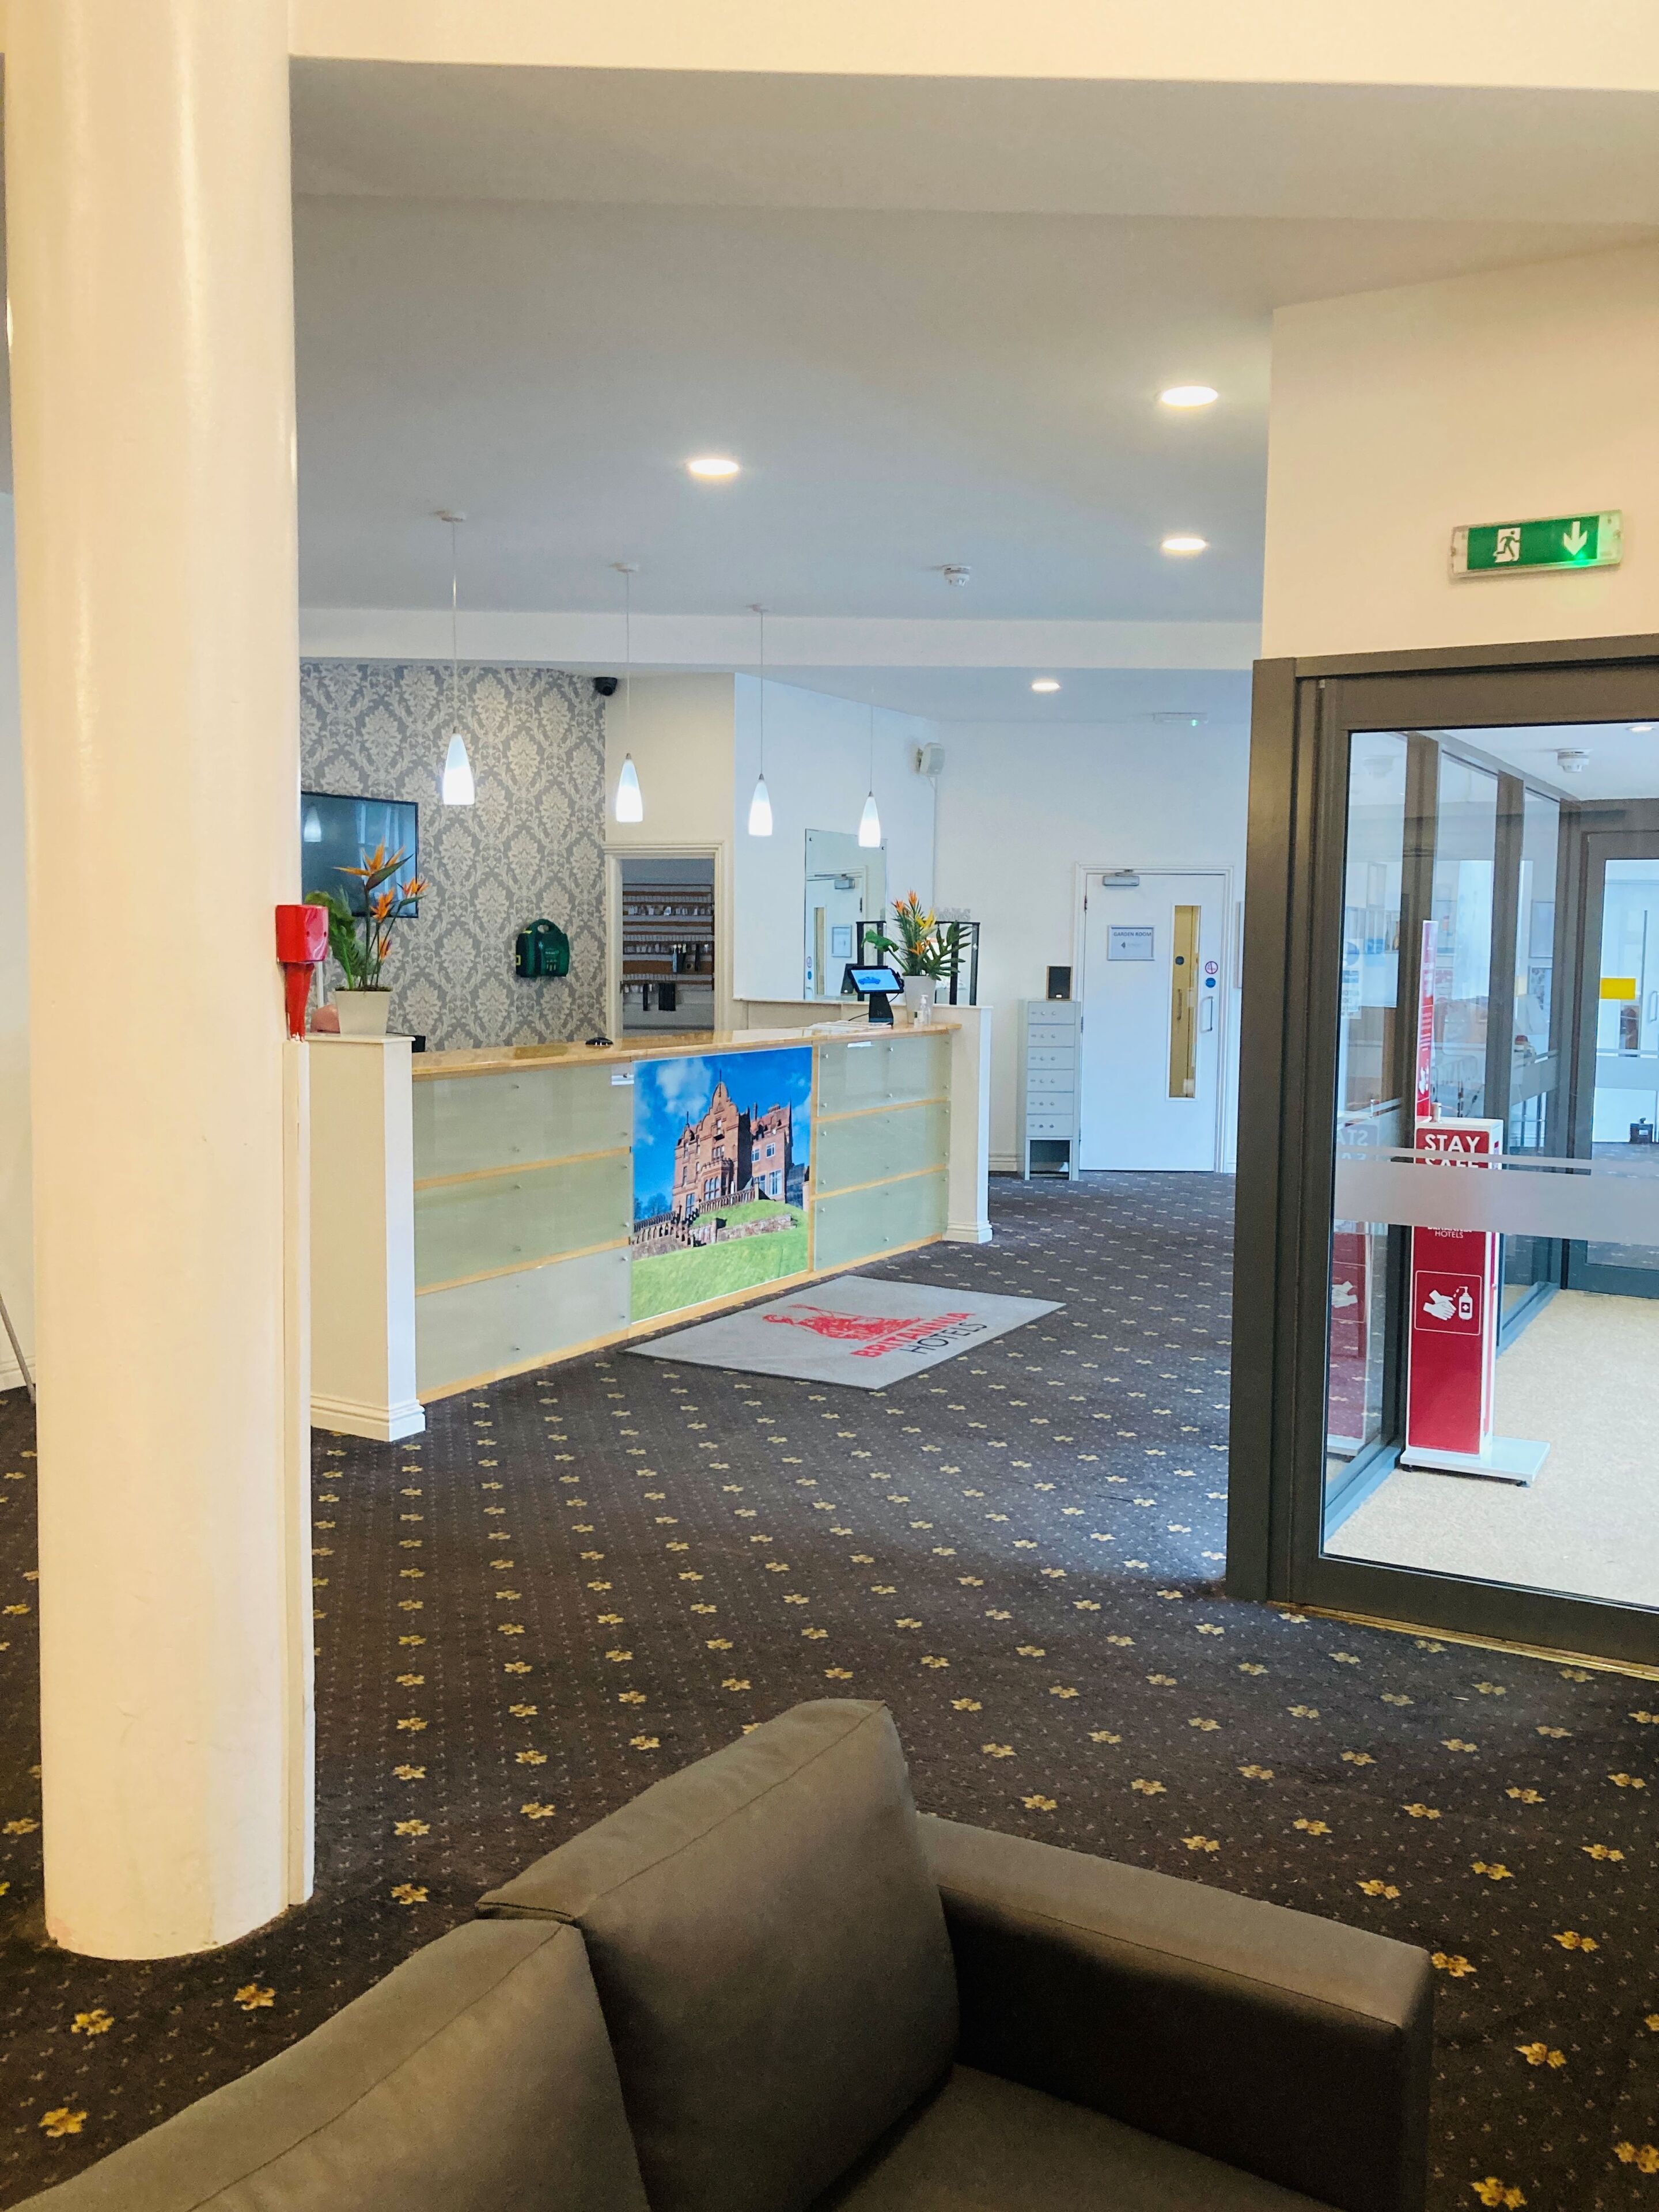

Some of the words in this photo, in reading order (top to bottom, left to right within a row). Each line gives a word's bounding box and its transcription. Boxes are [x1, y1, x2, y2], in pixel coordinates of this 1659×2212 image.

[1425, 1134, 1480, 1153] STAY
[1434, 1230, 1464, 1238] HOTELS
[849, 1312, 976, 1357] BRITANNIA
[899, 1321, 987, 1354] HOTELS
